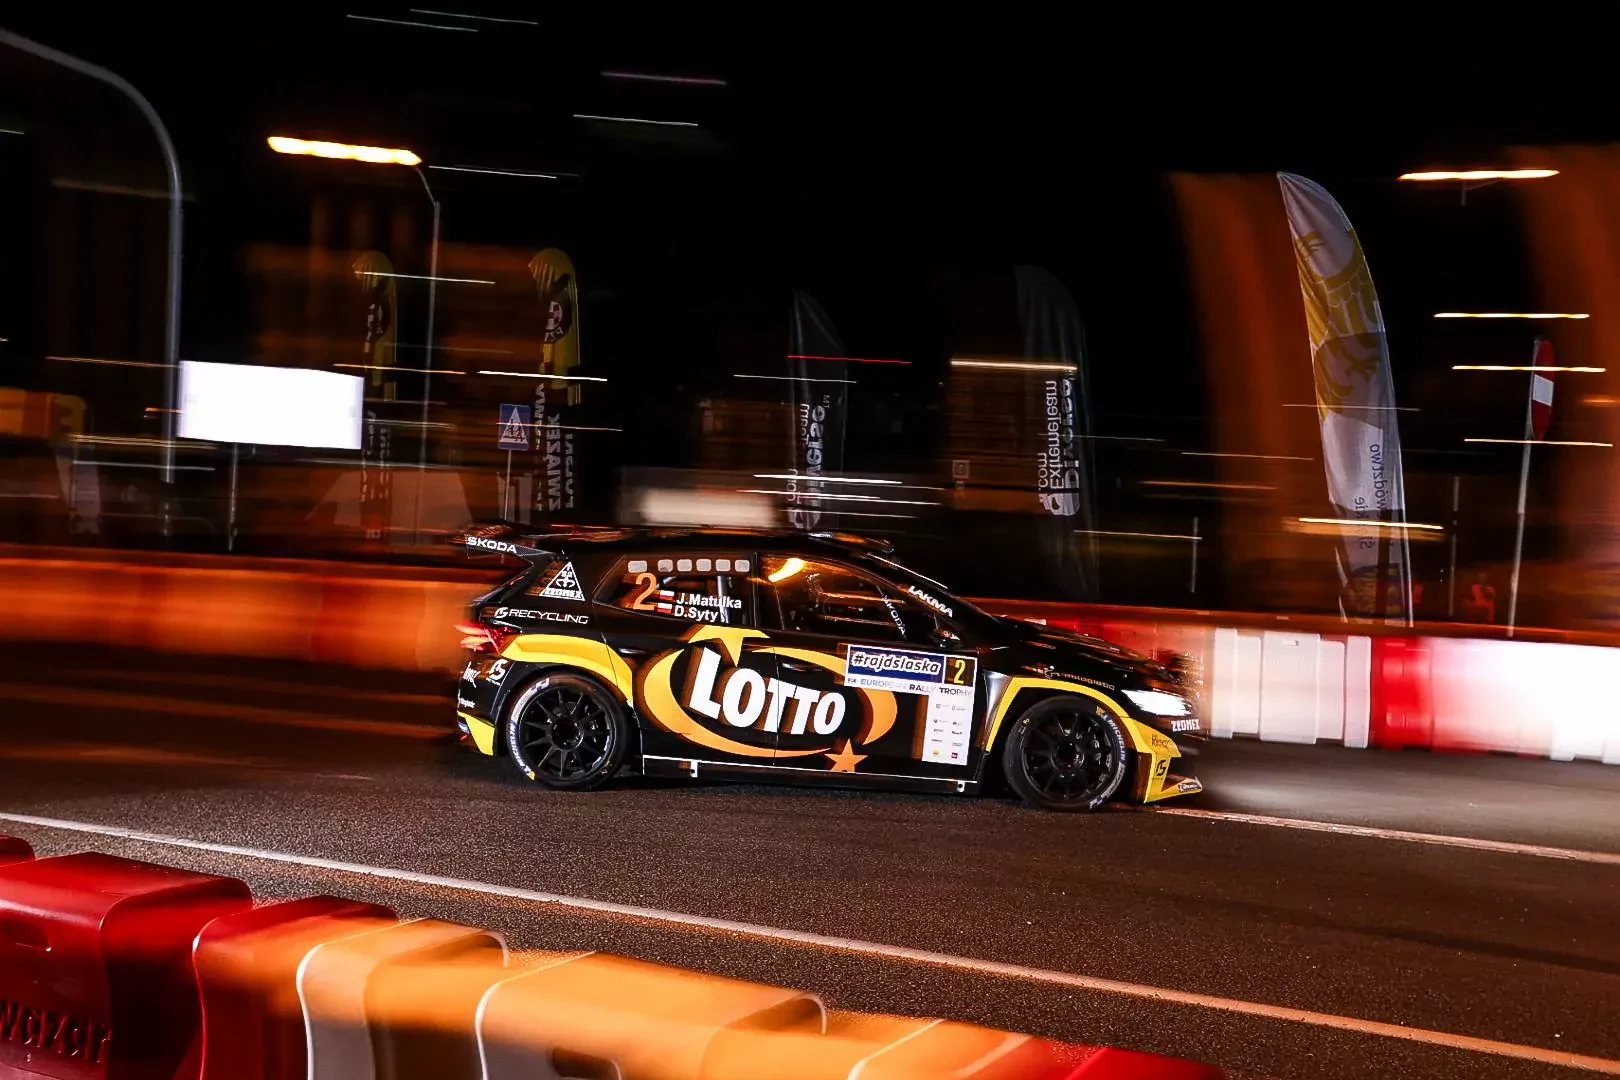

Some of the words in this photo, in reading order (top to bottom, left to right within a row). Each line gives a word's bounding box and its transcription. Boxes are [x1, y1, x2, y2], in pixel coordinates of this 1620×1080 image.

[632, 572, 658, 611] 2
[676, 592, 742, 609] J.Matulka
[908, 585, 953, 618] LAKMA
[508, 608, 589, 624] RECYCLING
[674, 605, 719, 622] D.Syty
[852, 652, 940, 673] #rajdslaska
[953, 659, 966, 685] 2
[689, 647, 846, 735] LOTTO
[909, 683, 936, 693] RALLY
[939, 686, 973, 697] TROPHY
[1106, 719, 1127, 762] MICHELIN
